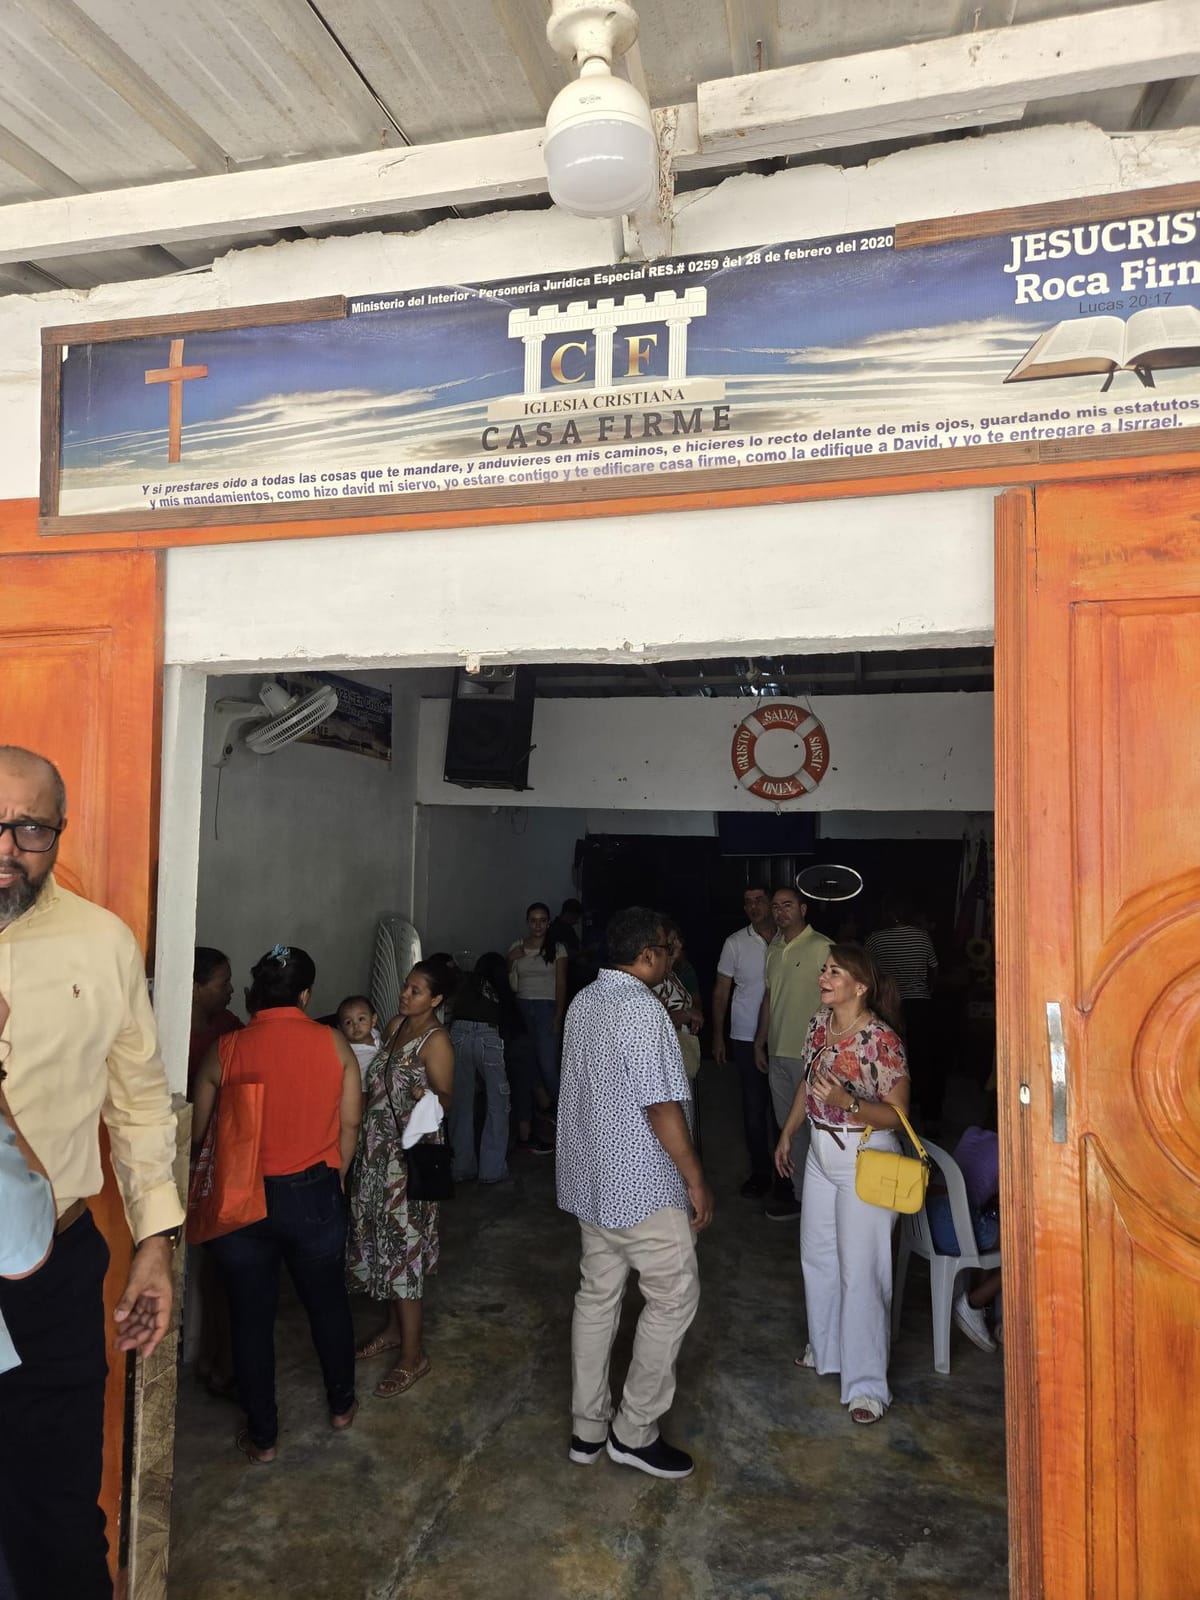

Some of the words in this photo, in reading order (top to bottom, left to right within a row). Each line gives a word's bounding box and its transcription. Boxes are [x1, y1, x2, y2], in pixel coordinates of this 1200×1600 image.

[1003, 210, 1200, 273] JESUCRIS
[352, 298, 404, 314] Ministerio
[408, 295, 424, 307] del
[428, 290, 470, 304] Interior
[479, 281, 540, 299] Personería
[543, 276, 591, 291] Jurídica
[594, 268, 645, 286] Especial
[648, 264, 685, 278] RES.#
[688, 260, 719, 273] 0259
[723, 255, 742, 268] del
[745, 253, 761, 266] 28
[765, 250, 781, 264] de
[784, 246, 832, 261] febrero
[836, 240, 856, 254] del
[860, 235, 894, 250] 2020
[1015, 272, 1110, 305] Roca
[1079, 299, 1124, 314] Lucas
[1129, 292, 1172, 308] 20:17
[551, 340, 588, 384] C
[624, 333, 658, 377] F
[524, 398, 588, 415] IGLESIA
[593, 388, 685, 409] CRISTIANA
[142, 485, 150, 496] Y
[152, 483, 162, 494] si
[164, 481, 219, 498] prestares
[222, 477, 248, 489] oido
[251, 478, 258, 487] a
[262, 474, 296, 486] todas
[299, 472, 316, 484] las
[320, 471, 356, 482] cosas
[360, 468, 383, 482] que
[386, 466, 400, 478] te
[404, 460, 464, 476] mandare,
[466, 461, 475, 474] y
[478, 454, 551, 471] anduvieres
[554, 454, 572, 464] en
[576, 450, 600, 462] mis
[604, 445, 668, 460] caminos,
[672, 444, 682, 454] e
[686, 437, 744, 453] hicieres
[749, 436, 762, 447] lo
[768, 433, 808, 446] recto
[813, 428, 872, 442] delante
[877, 424, 896, 436] de
[901, 421, 930, 434] mis
[935, 418, 974, 433] ojos,
[980, 410, 1070, 430] guardando
[1076, 406, 1108, 418] mis
[1114, 398, 1200, 416] estatutos
[481, 419, 582, 451] CASA
[598, 405, 731, 442] FIRME
[149, 500, 156, 510] y
[160, 496, 180, 507] mis
[183, 491, 274, 506] mandamientos,
[277, 487, 310, 500] como
[314, 484, 338, 498] hizo
[342, 482, 375, 496] david
[379, 480, 394, 492] mi
[398, 476, 441, 492] siervo,
[444, 476, 458, 490] yo
[463, 472, 504, 486] estare
[508, 468, 558, 484] contigo
[563, 468, 571, 482] y
[574, 466, 589, 478] te
[593, 460, 654, 476] edificare
[659, 457, 693, 470] casa
[698, 452, 742, 468] firme,
[746, 451, 786, 463] como
[792, 446, 805, 460] la
[810, 441, 873, 457] edifique
[878, 441, 888, 452] a
[893, 434, 943, 450] David,
[948, 436, 958, 448] y
[963, 434, 982, 447] yo
[988, 430, 1004, 443] te
[1010, 424, 1095, 440] entregare
[1101, 422, 1112, 433] a
[1118, 414, 1183, 432] Isrrael.
[764, 709, 798, 722] SALVA
[736, 730, 751, 771] CRISTO
[809, 736, 823, 772] JESUS
[762, 782, 793, 794] ONLY
